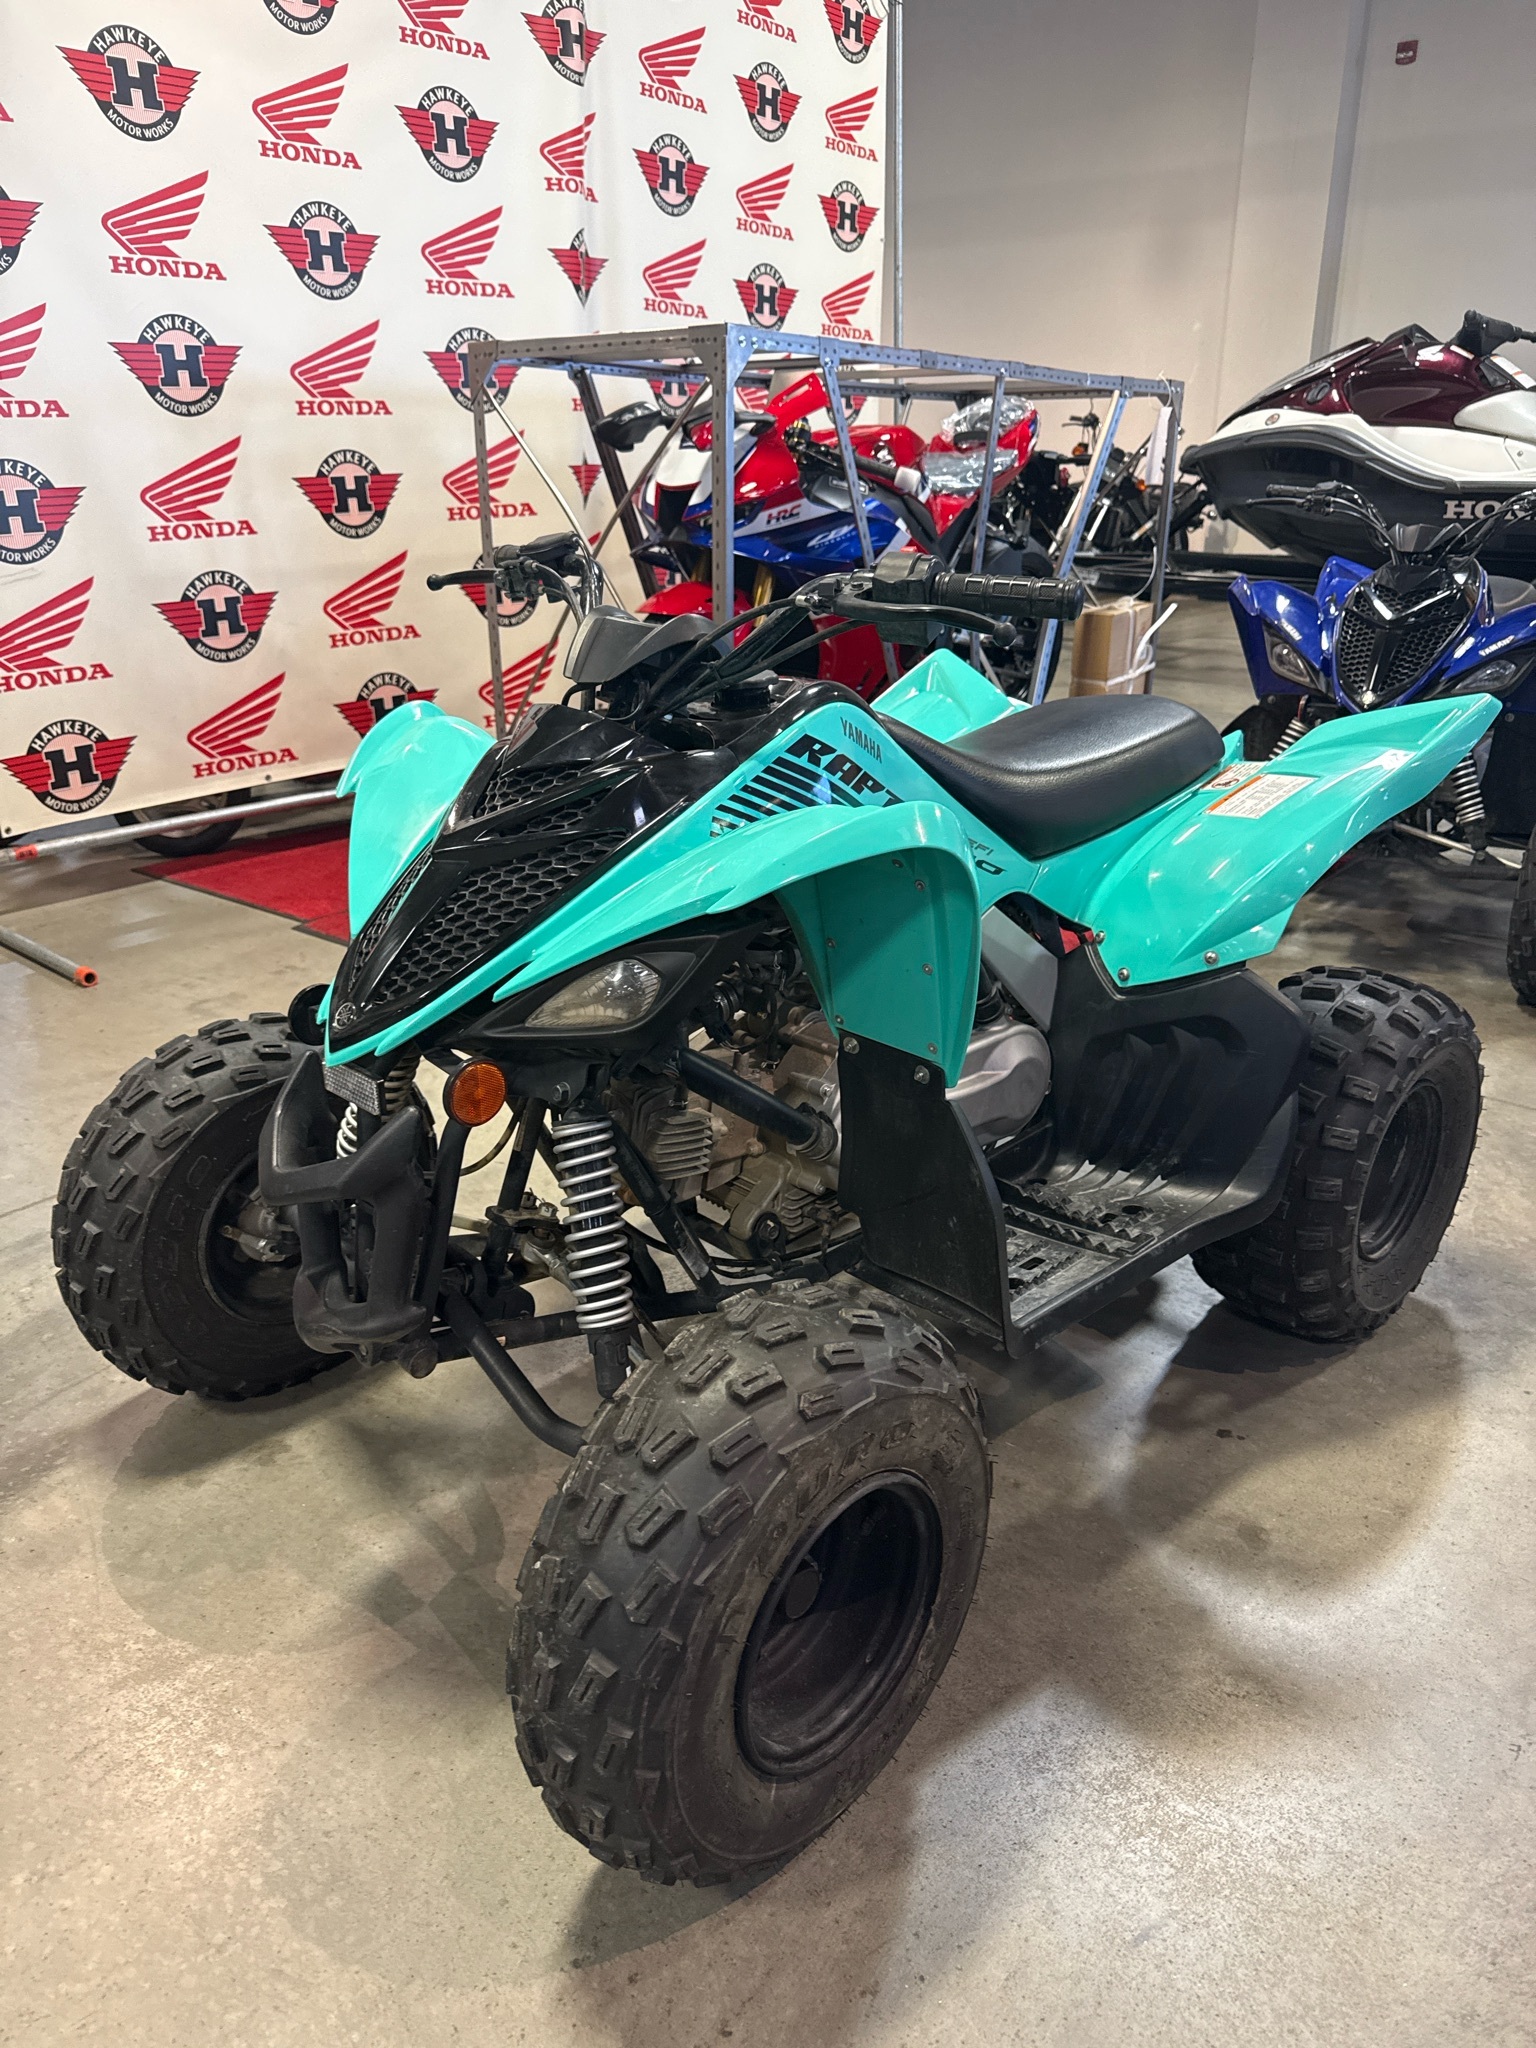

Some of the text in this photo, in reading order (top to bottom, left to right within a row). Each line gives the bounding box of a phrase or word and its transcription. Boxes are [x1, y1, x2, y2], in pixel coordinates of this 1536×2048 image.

[269, 1, 328, 32] MOTOR WORKS
[545, 0, 584, 17] HAWKE
[737, 9, 798, 43] HONDA
[842, 5, 864, 45] H
[93, 26, 165, 63] HAWKEYE
[398, 26, 491, 61] HONDA
[106, 54, 164, 112] H
[751, 64, 786, 89] HAWKEYE
[421, 87, 474, 117] HAWKEYE
[639, 81, 708, 115] HONDA
[756, 82, 782, 122] H
[106, 108, 174, 139] MOTOR WORKS
[430, 111, 471, 156] H
[258, 140, 362, 170] HONDA
[652, 135, 692, 163] HAWKEYE
[825, 136, 879, 162] HONDA
[428, 156, 478, 180] MOTOR WORKS
[658, 155, 687, 195] H
[293, 201, 351, 231] HAWKEYE
[736, 217, 794, 241] HONDA
[837, 200, 859, 233] H
[303, 228, 349, 273] H
[108, 256, 227, 281] HONDA
[303, 274, 358, 299] MOTOR WORKS
[425, 279, 515, 298] HONDA
[755, 283, 778, 316] H
[644, 297, 709, 319] HONDA
[143, 316, 209, 344] HAWKEYE
[448, 329, 494, 352] HAWKE
[821, 323, 874, 342] HONDA
[153, 344, 209, 388] H
[0, 400, 70, 418] NDA
[154, 391, 218, 415] MOTOR WORKS
[296, 400, 393, 416] HONDA
[0, 461, 46, 488] KEYE
[319, 451, 375, 475] HAWKEYE
[331, 475, 371, 513] H
[0, 489, 45, 535] H
[329, 515, 382, 537] MOTOR WORKS
[148, 519, 258, 542] HONDA
[0, 537, 56, 562] TOR WORKS
[185, 570, 248, 598] HAWKEYE
[197, 596, 246, 638] H
[195, 636, 256, 662] MOTOR WORKS
[329, 625, 421, 648] HONDA
[0, 663, 114, 693] HONDA
[360, 674, 412, 699] HAWKEYE
[31, 720, 102, 752] HAWKEYE
[840, 717, 883, 764] YAMAHA
[44, 743, 100, 791] H
[192, 748, 298, 778] HONDA
[783, 733, 905, 808] RAPT
[44, 784, 111, 814] MOTOR WORKS
